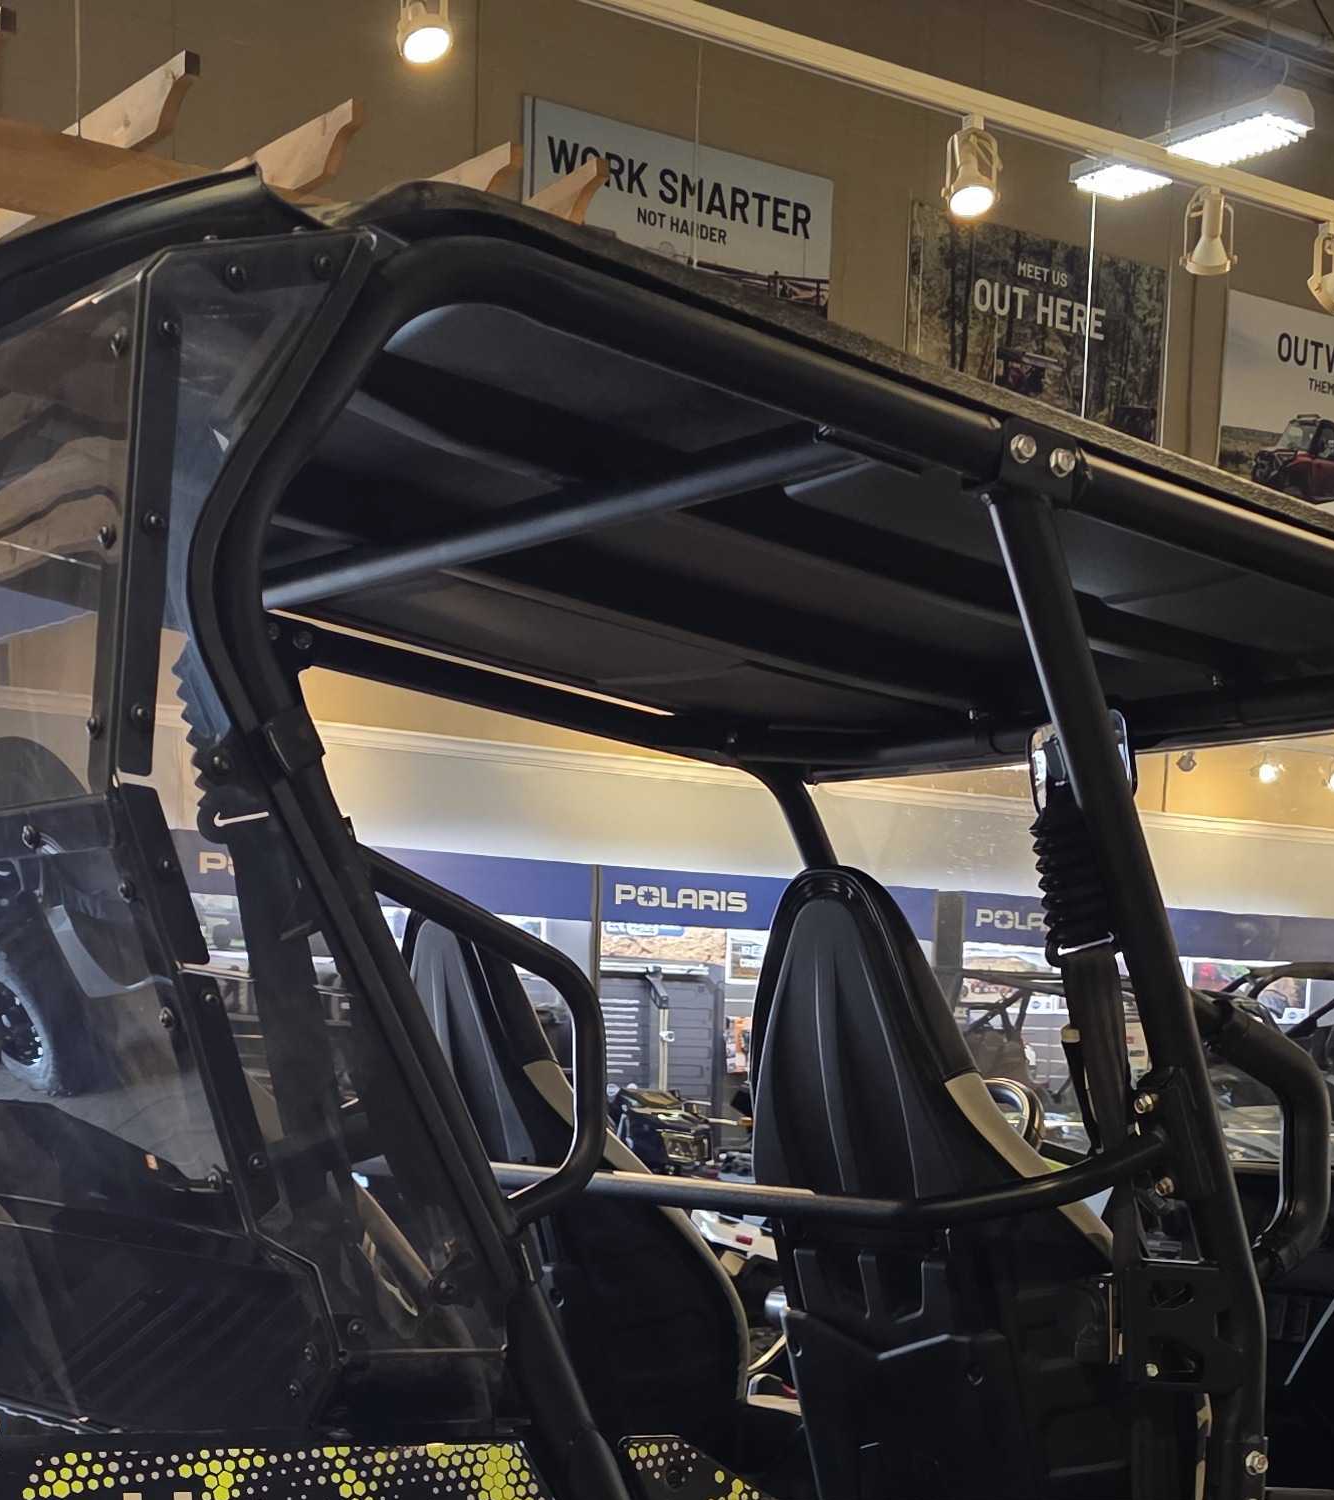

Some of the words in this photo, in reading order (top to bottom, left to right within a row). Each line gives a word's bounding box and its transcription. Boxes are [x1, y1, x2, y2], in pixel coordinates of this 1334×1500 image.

[659, 168, 811, 239] SMARTER
[637, 207, 667, 230] NOT
[670, 218, 727, 245] HARDER
[1017, 261, 1050, 282] MEET
[1052, 270, 1068, 288] US
[974, 278, 1029, 319] OUT
[1037, 292, 1106, 340] HERE
[1309, 378, 1334, 396] THEM
[615, 883, 748, 913] POLARIS
[975, 908, 1048, 932] POLA
